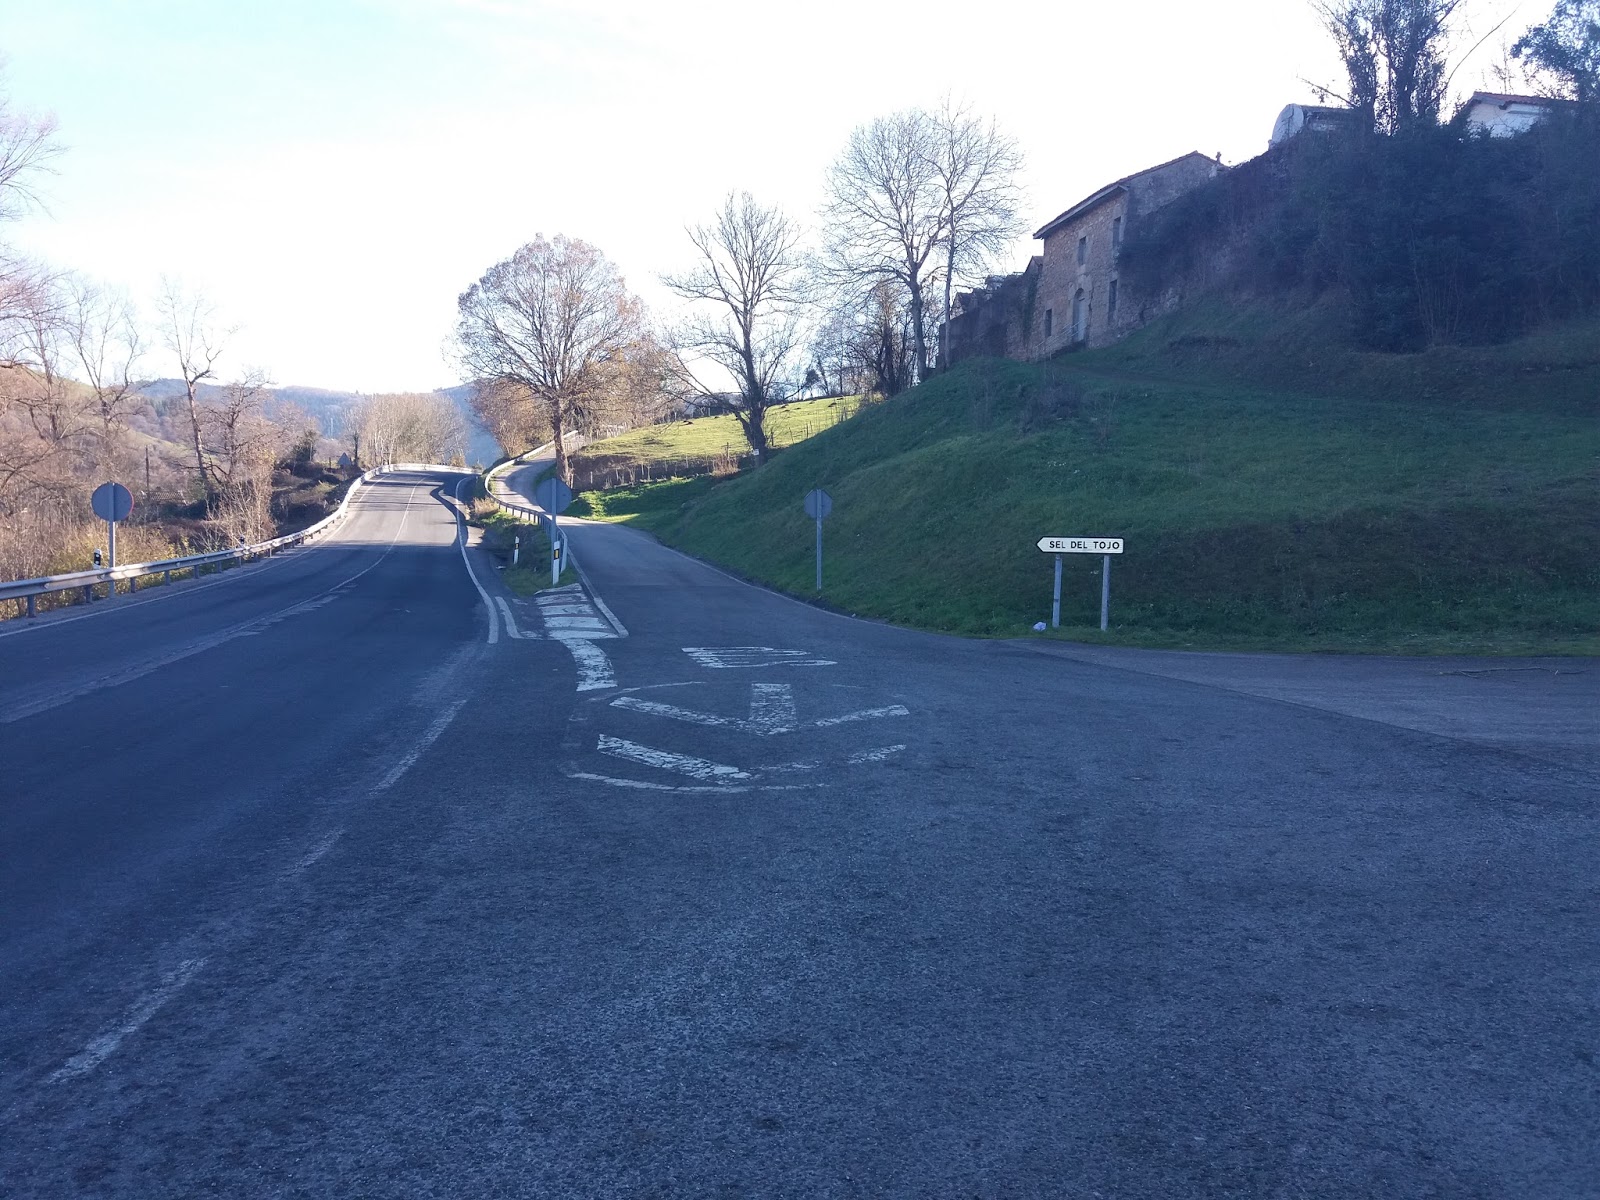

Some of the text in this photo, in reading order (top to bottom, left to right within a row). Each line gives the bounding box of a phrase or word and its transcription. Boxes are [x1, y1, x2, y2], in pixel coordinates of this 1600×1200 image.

[1049, 541, 1120, 550] SEL DEL TOJO
